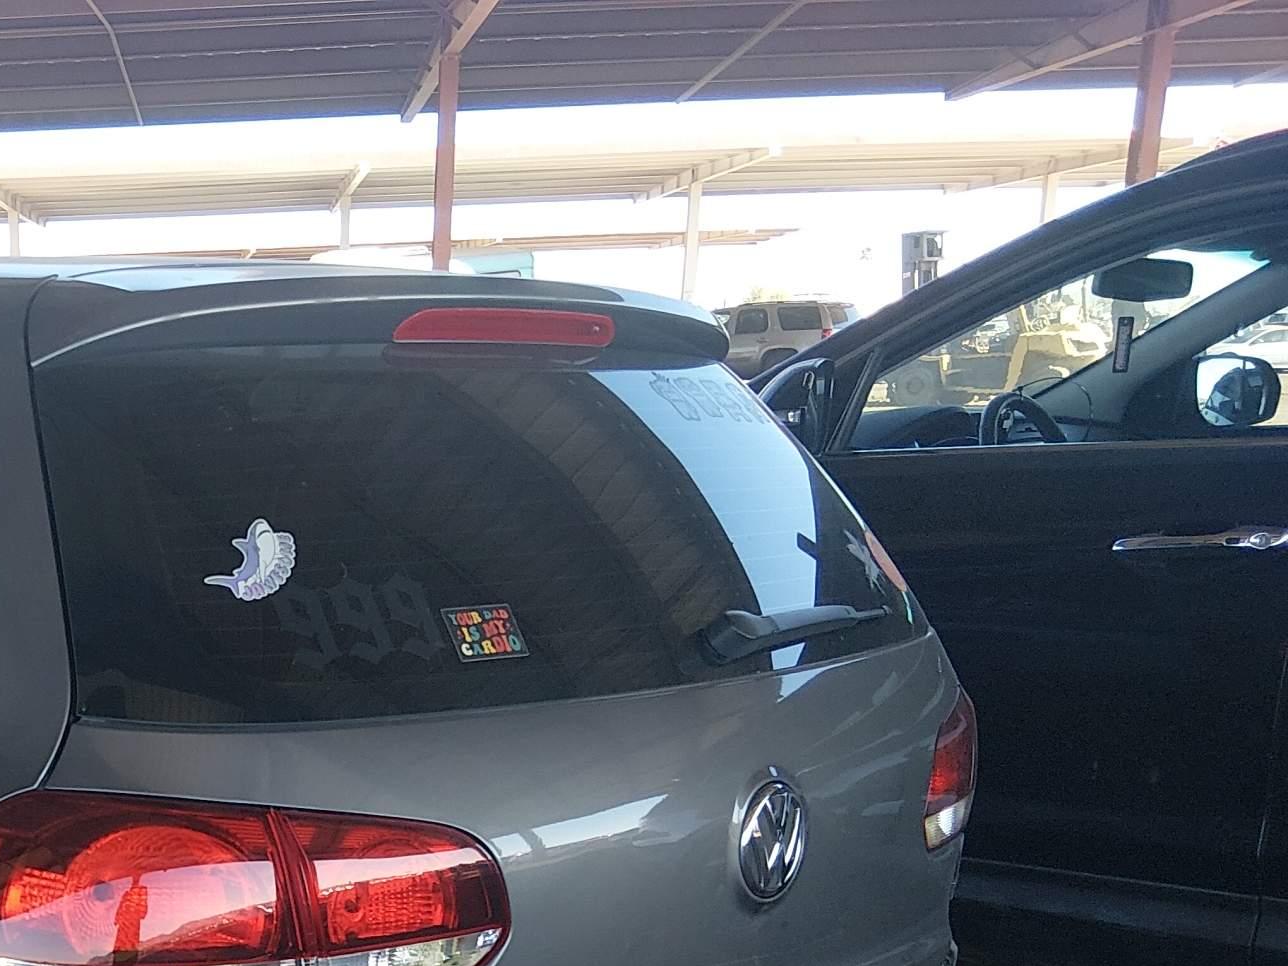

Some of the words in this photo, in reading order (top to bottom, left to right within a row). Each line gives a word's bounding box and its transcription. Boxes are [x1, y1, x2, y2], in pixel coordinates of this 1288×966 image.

[448, 611, 482, 626] YOUR
[482, 608, 509, 620] DAD
[461, 626, 480, 642] IS
[482, 619, 506, 638] MY
[461, 634, 521, 656] CARDIO
